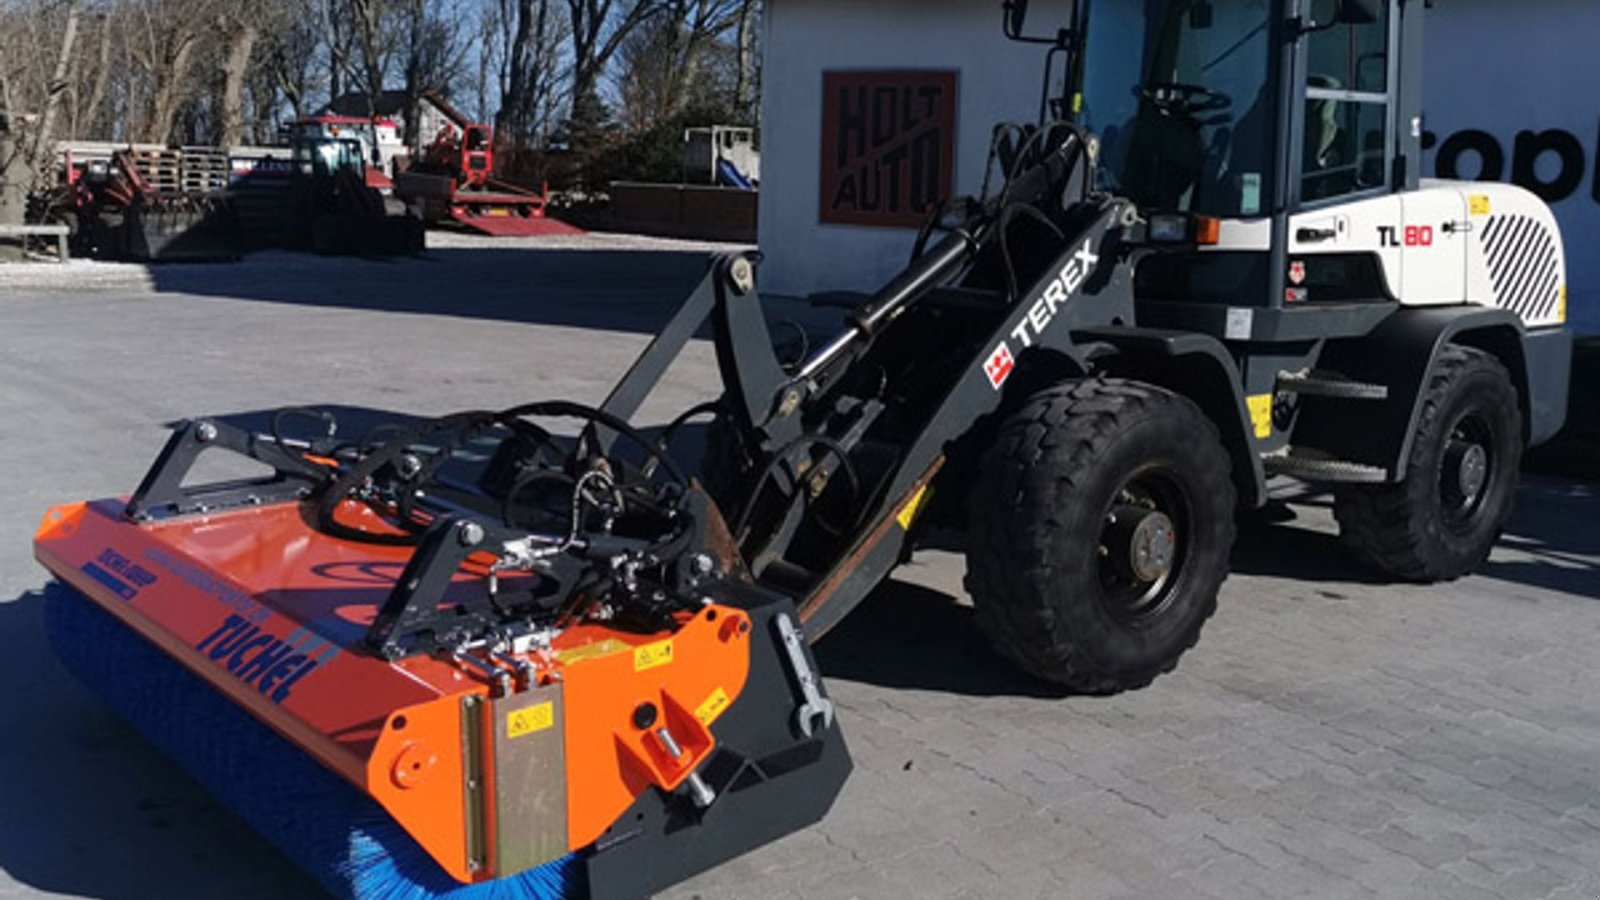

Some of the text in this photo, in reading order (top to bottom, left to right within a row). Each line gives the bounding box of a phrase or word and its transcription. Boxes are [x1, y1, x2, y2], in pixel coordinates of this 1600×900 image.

[831, 127, 940, 214] AUTO
[838, 85, 943, 170] HOLT
[1011, 238, 1098, 347] TEREX
[195, 614, 319, 704] TUCHEL
